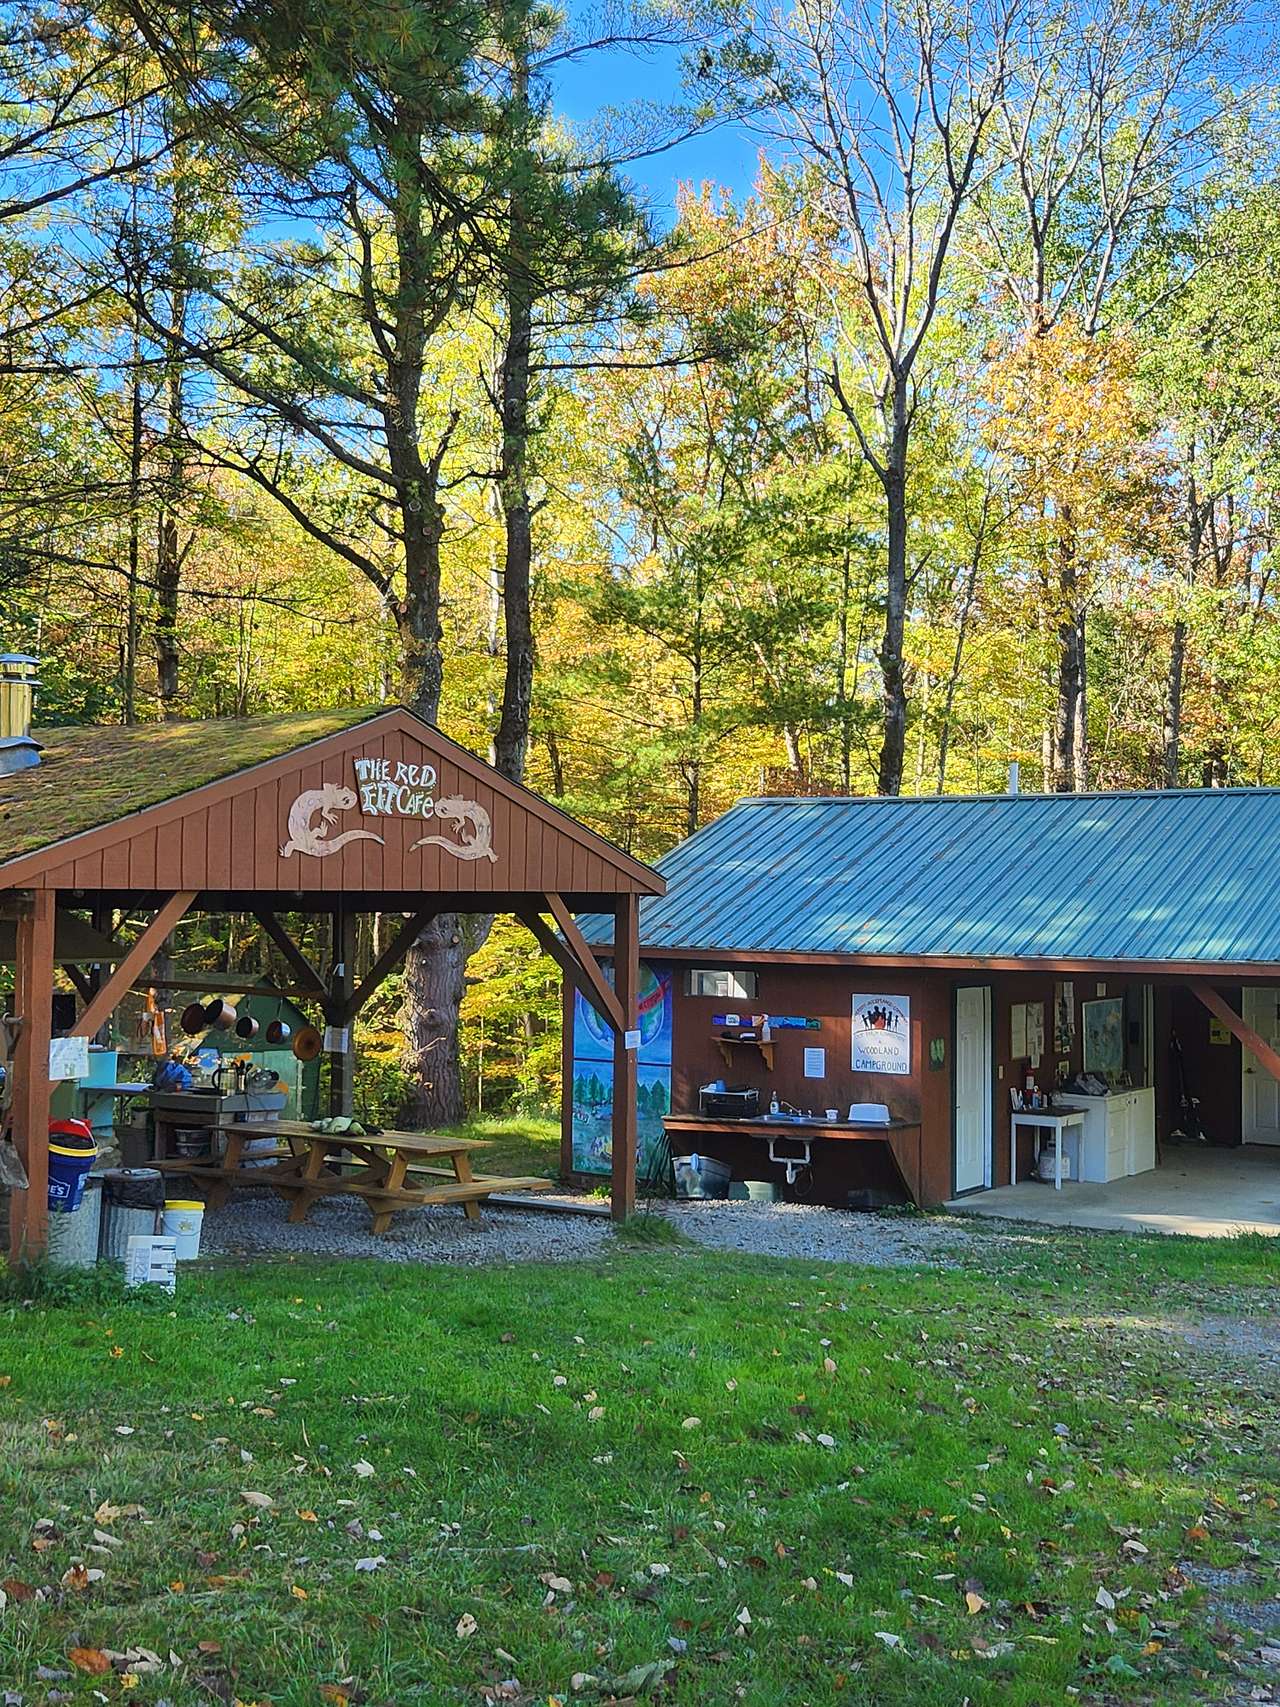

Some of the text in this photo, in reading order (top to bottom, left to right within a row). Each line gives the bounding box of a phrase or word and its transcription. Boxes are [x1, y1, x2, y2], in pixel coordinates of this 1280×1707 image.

[354, 757, 391, 781] THE
[857, 1046, 899, 1055] WOODLAND
[856, 1059, 907, 1072] CAMPGROUND
[48, 1184, 65, 1195] E'S
